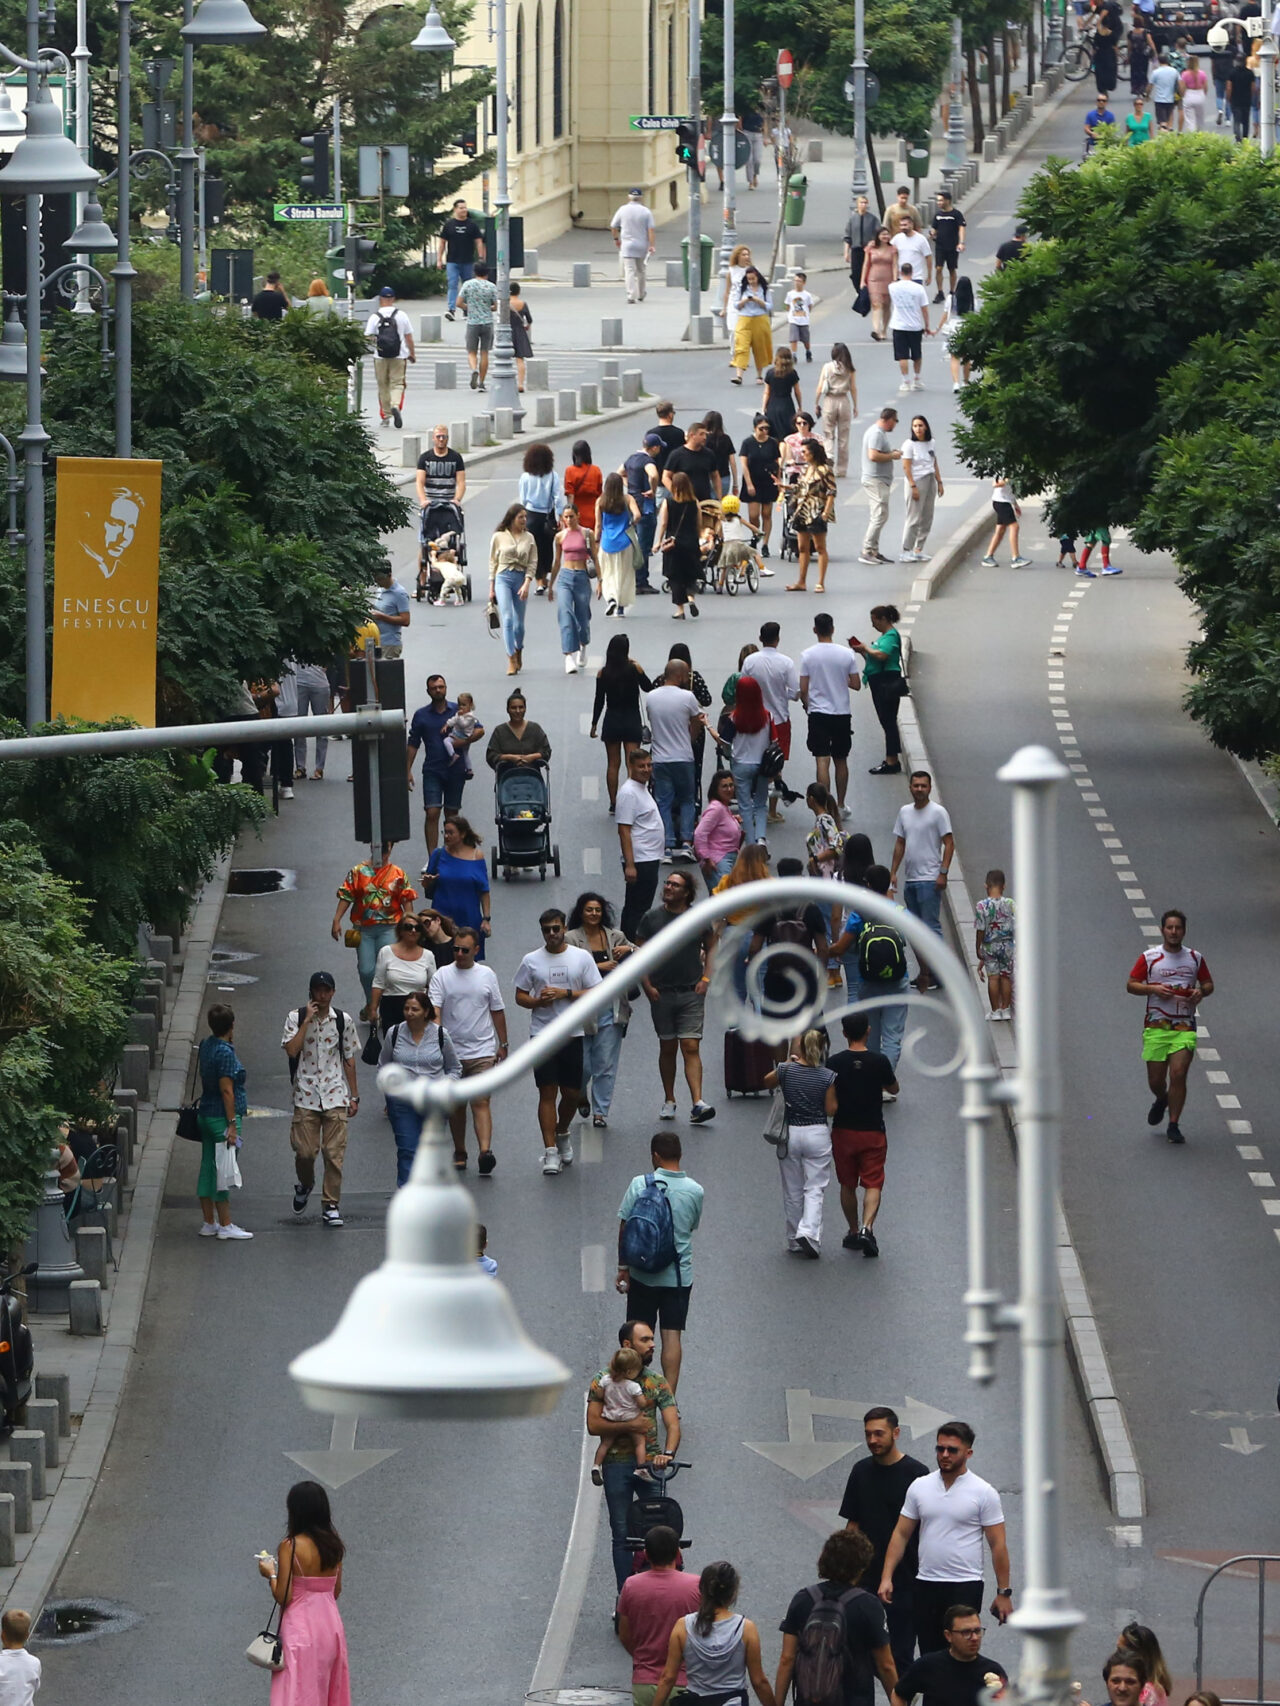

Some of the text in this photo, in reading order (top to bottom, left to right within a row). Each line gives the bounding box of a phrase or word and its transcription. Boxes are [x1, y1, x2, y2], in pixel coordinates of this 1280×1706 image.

[641, 117, 661, 128] Calea
[290, 207, 344, 219] Strada Banului
[63, 598, 149, 614] ENESCU
[63, 618, 147, 629] FESTIVAL
